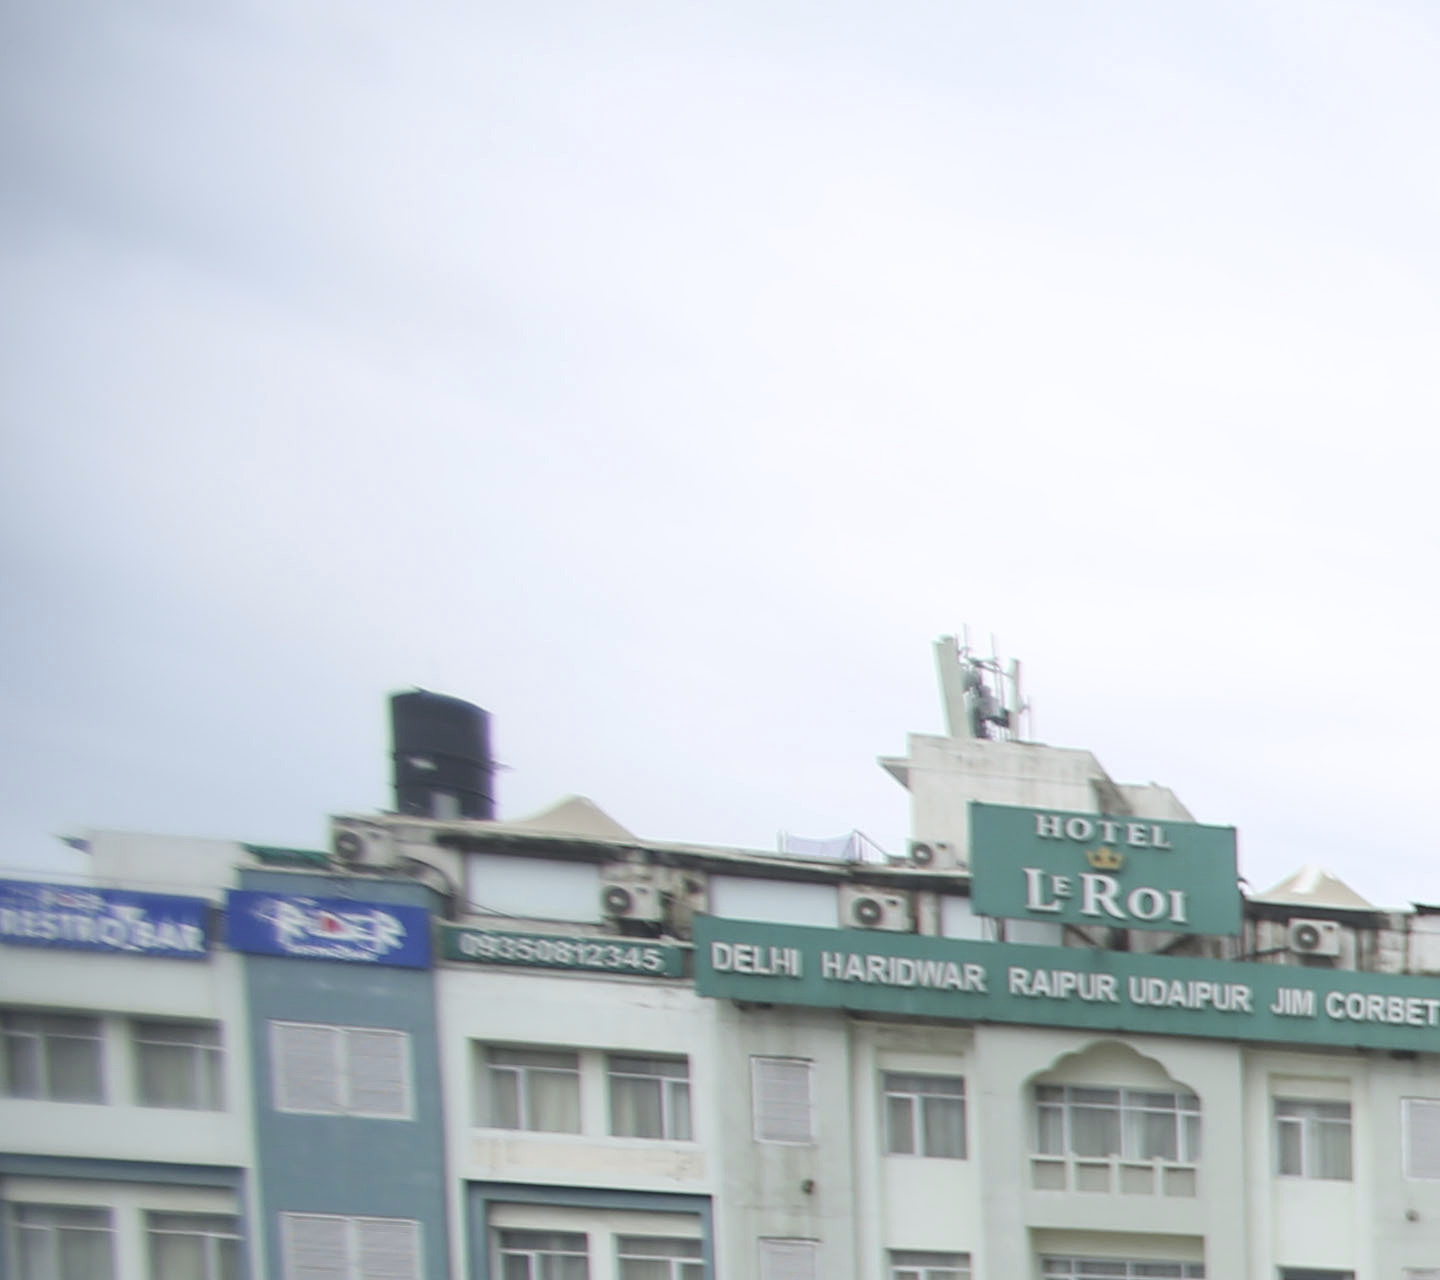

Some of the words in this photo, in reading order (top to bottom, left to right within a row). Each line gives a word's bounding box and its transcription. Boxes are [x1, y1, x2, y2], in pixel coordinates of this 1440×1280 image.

[1035, 814, 1173, 851] HOTEL
[459, 932, 668, 973] 09350812345
[711, 941, 803, 978] DELHI
[821, 951, 988, 994] HARIDWAR
[1008, 966, 1121, 1002] RAIPUR
[1128, 975, 1254, 1013] UDAIPUR
[1270, 988, 1316, 1018] JIM
